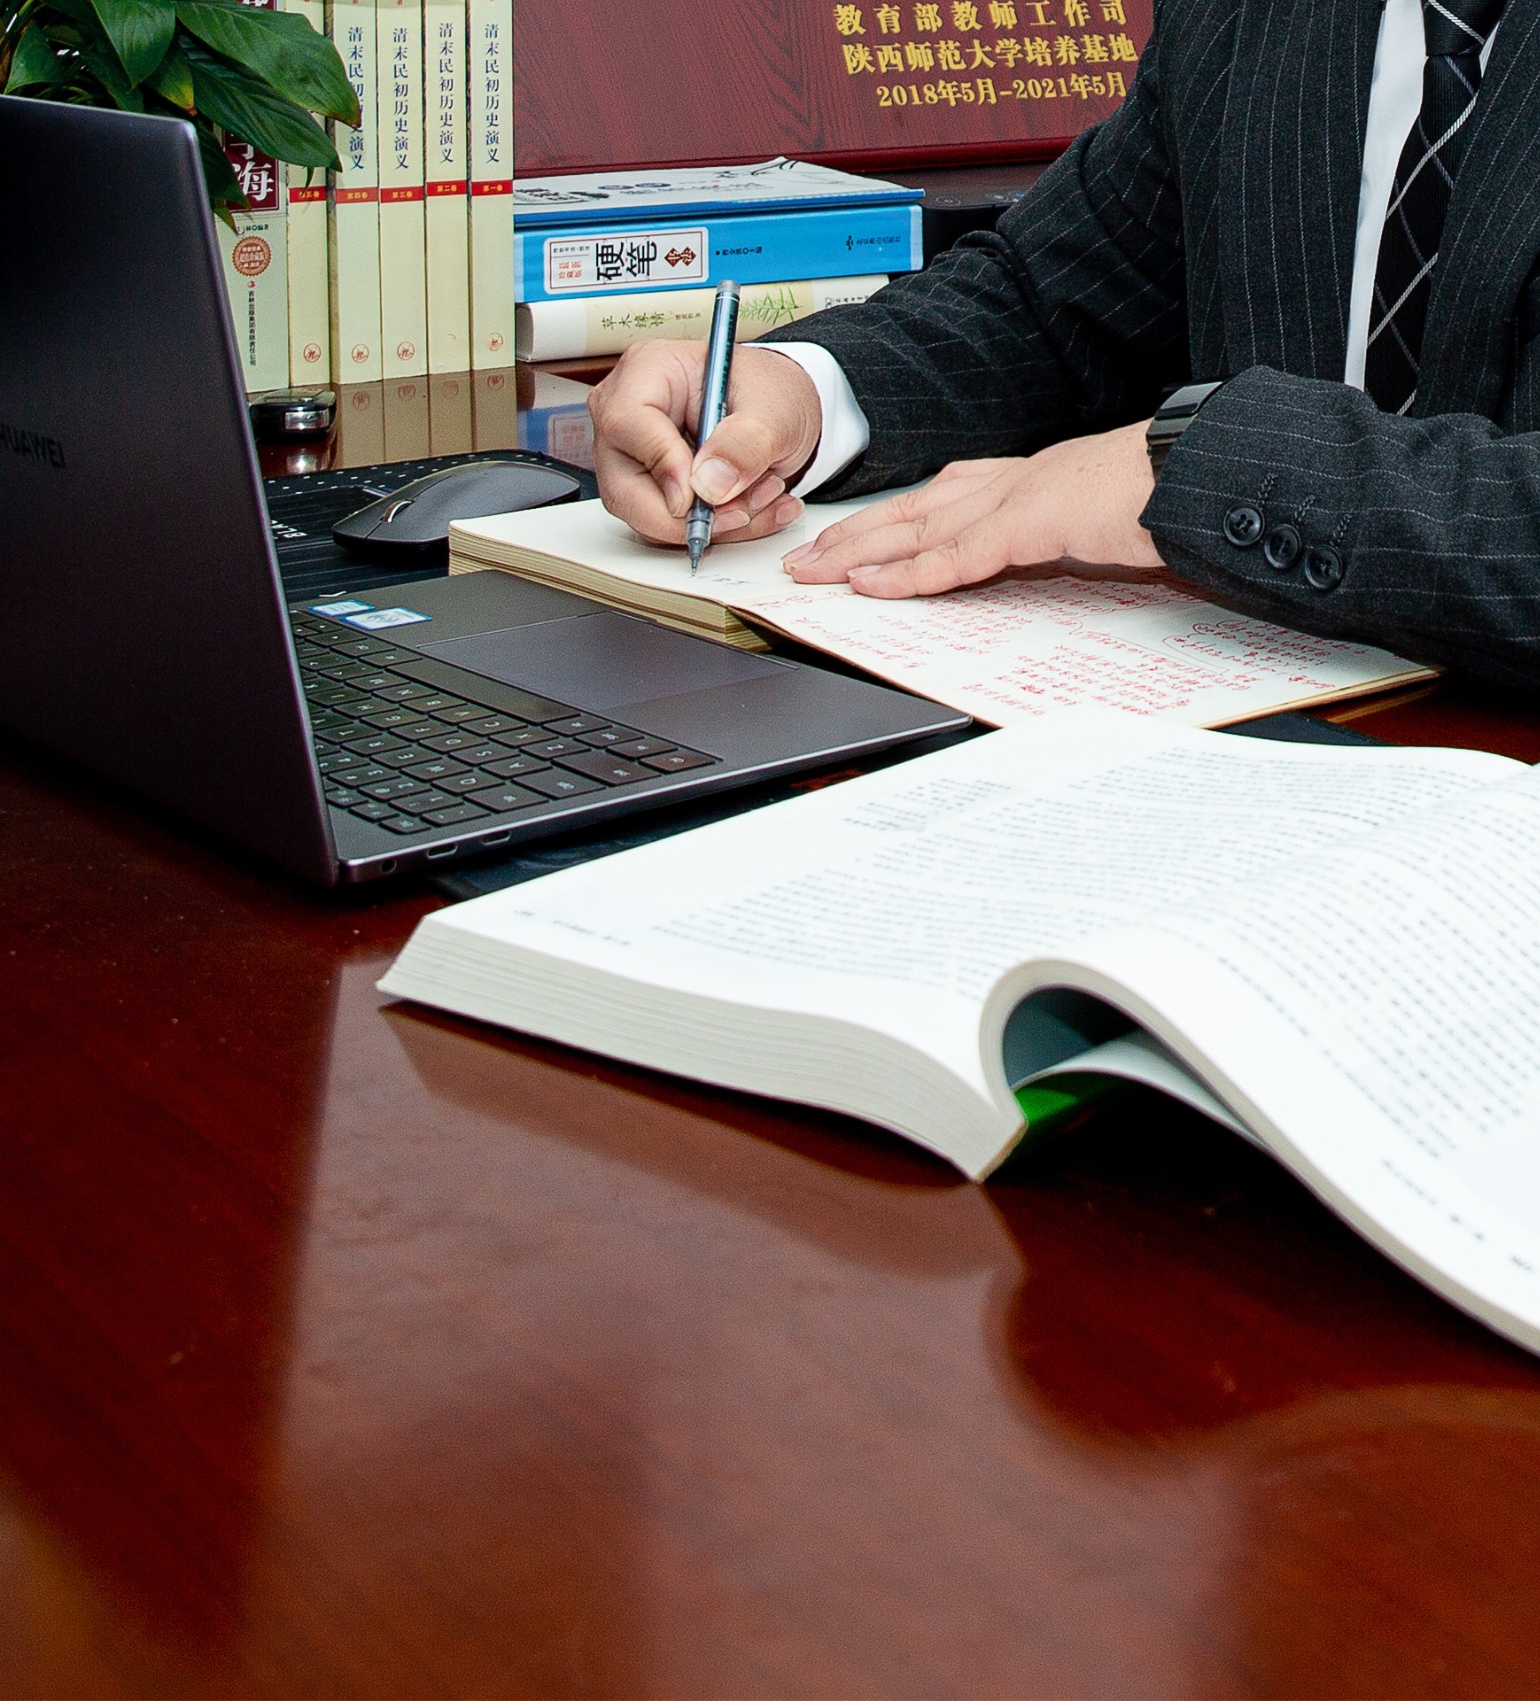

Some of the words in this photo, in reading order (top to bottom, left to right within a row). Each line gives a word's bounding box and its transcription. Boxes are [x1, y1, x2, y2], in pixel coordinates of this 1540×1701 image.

[347, 26, 365, 170] 清末民初演义
[393, 27, 409, 170] 清末民初历史演义
[439, 23, 454, 163] 清末民初历史演义
[485, 24, 500, 163] 清末民初历史演义
[842, 32, 1138, 75] 陕西师范大学培养基地
[876, 71, 1127, 108] 2018年5月-2021年5月
[595, 240, 657, 280] 硬笔
